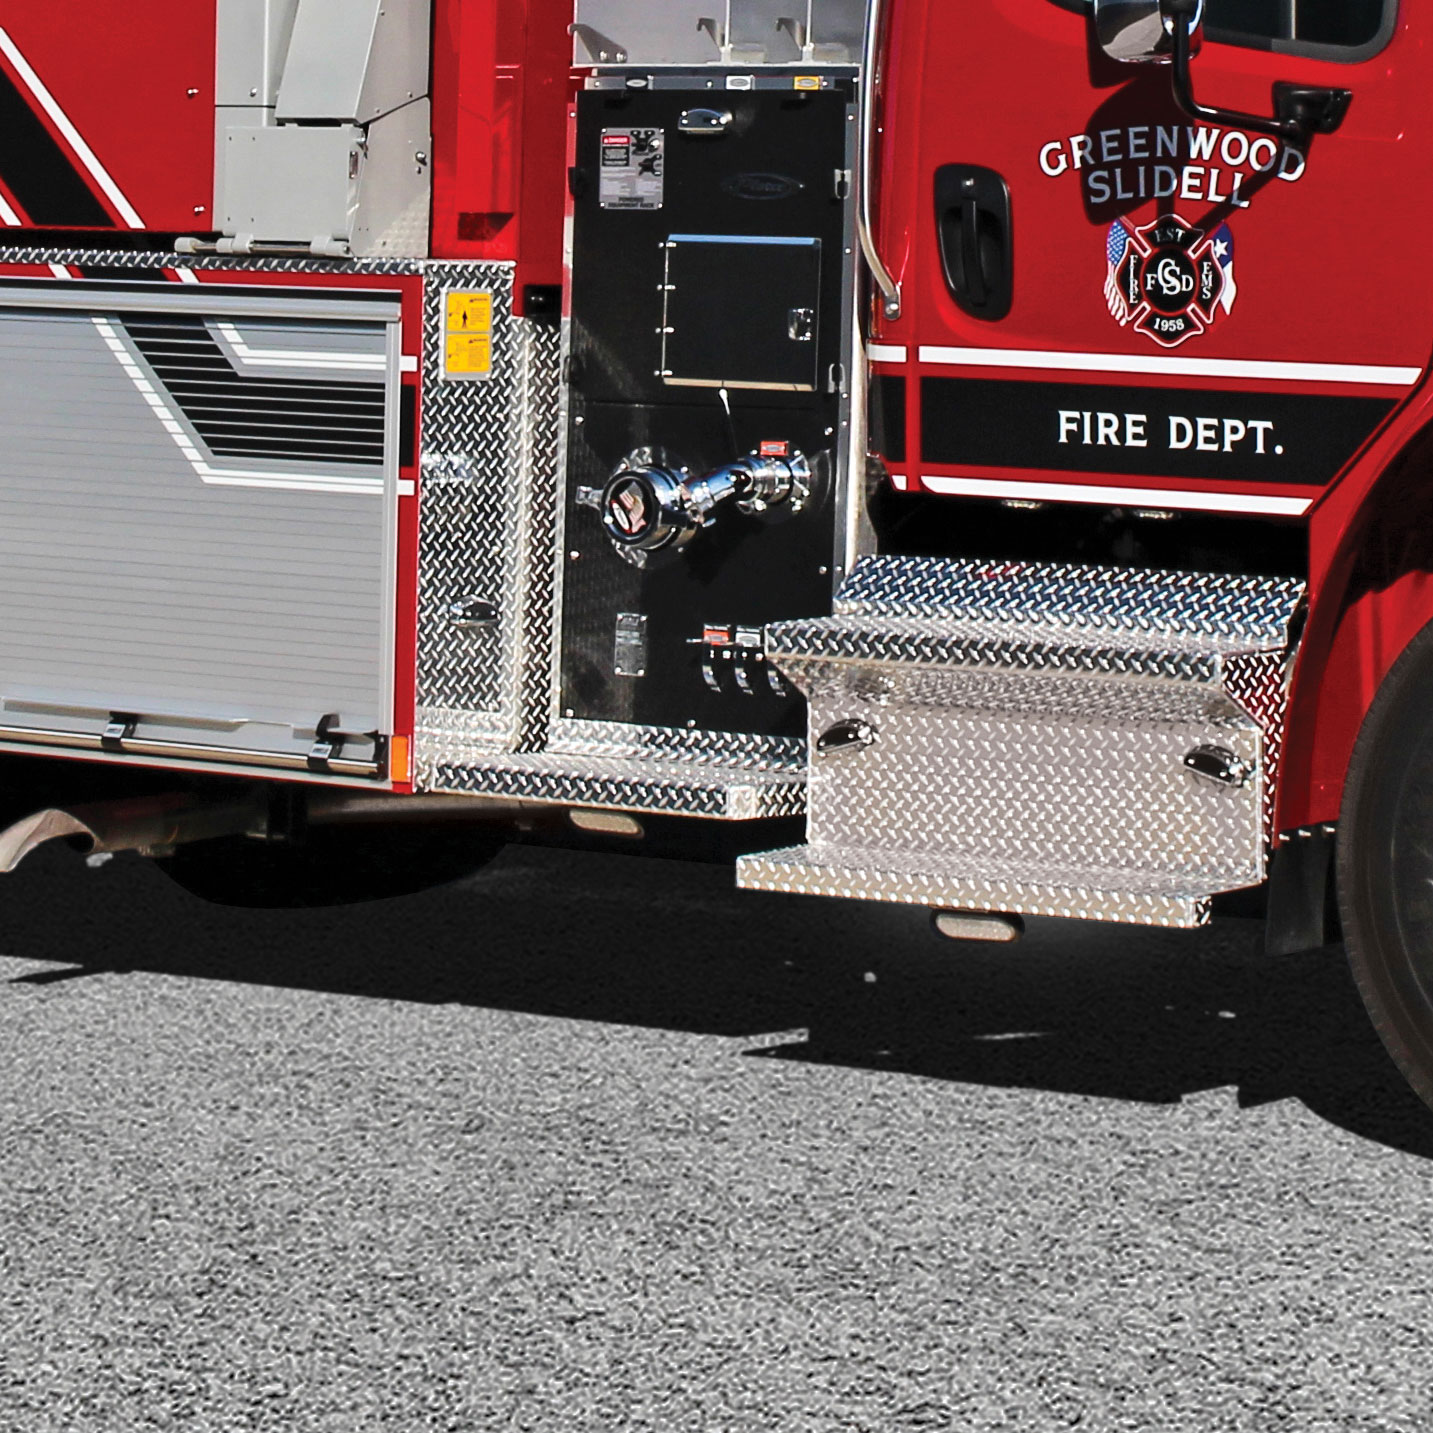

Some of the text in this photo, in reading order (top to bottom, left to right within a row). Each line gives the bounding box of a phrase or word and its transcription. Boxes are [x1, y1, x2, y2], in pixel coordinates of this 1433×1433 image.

[1039, 125, 1306, 182] GREENWOOD
[1087, 166, 1250, 208] SLIDELL
[1154, 228, 1186, 242] EST
[1129, 254, 1139, 304] FIRE
[1201, 261, 1213, 299] EMS
[1154, 317, 1185, 332] 1958
[1057, 410, 1284, 455] FIRE DEPT.
